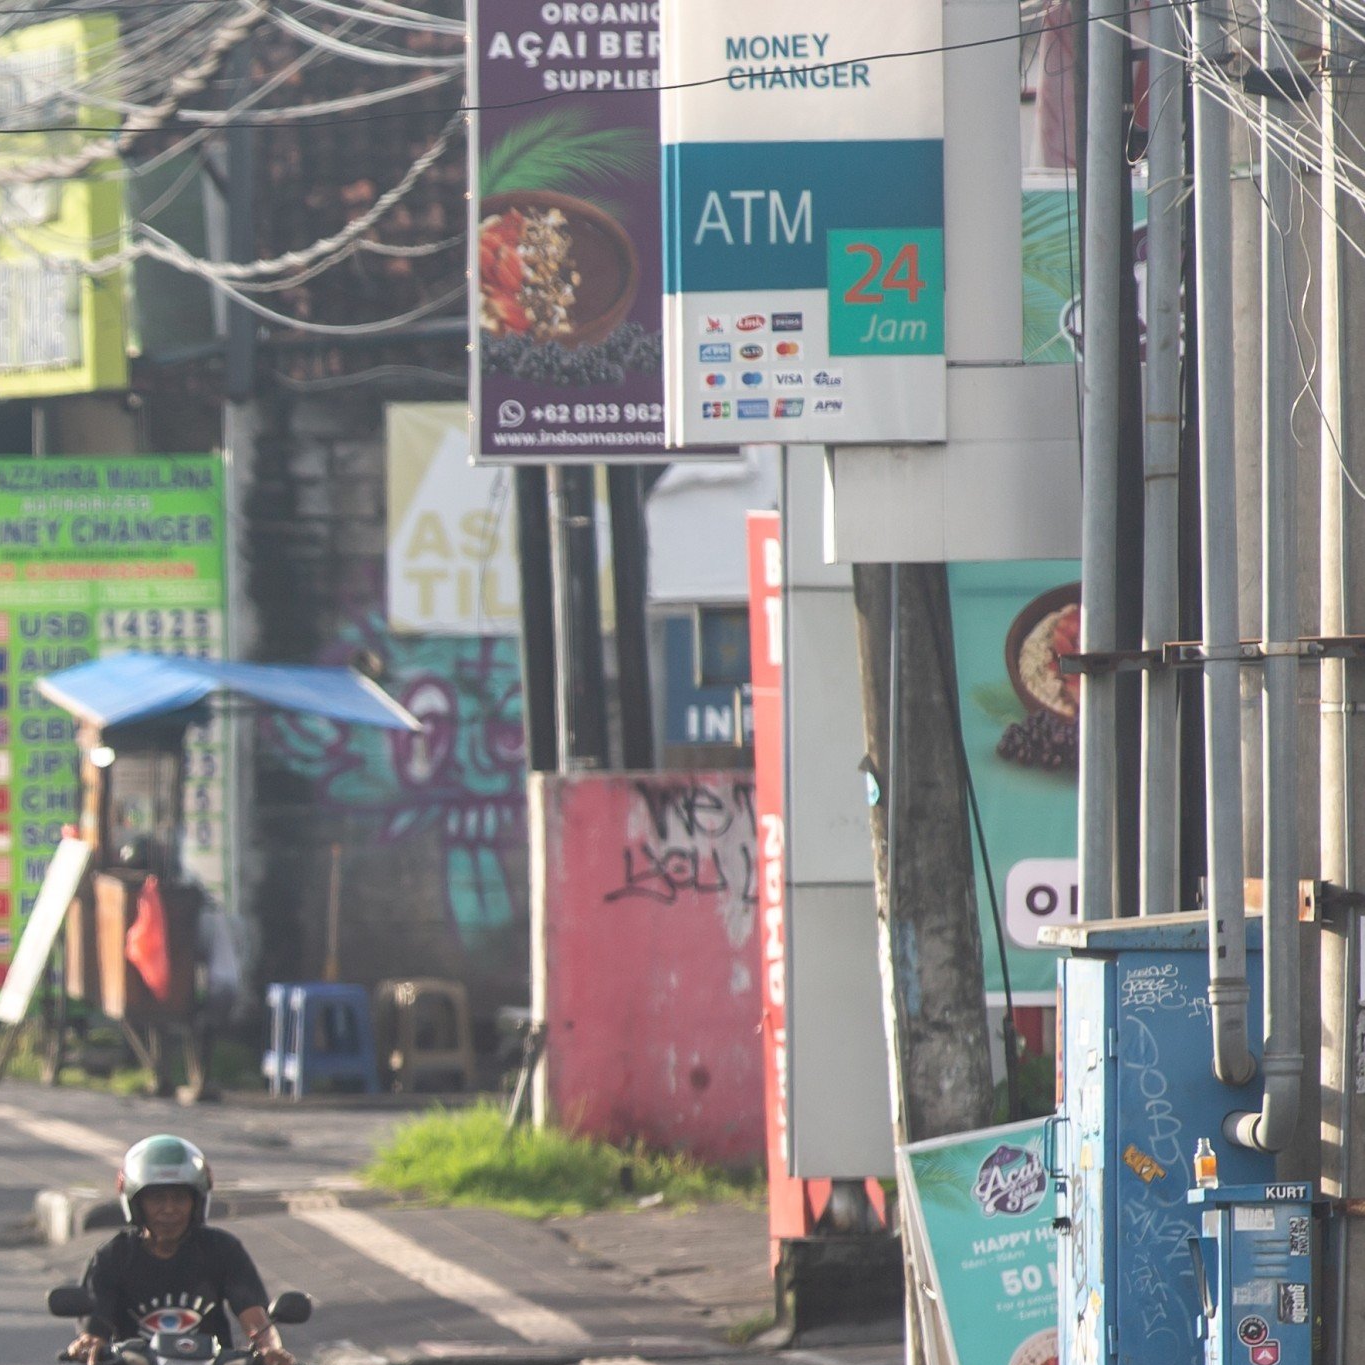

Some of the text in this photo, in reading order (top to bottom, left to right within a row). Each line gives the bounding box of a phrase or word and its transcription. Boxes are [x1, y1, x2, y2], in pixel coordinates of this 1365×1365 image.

[489, 31, 587, 68] AÇAI
[725, 33, 831, 60] MONEY
[728, 64, 871, 91] CHANGER
[694, 190, 813, 245] ATM
[843, 243, 927, 304] 24
[860, 312, 928, 343] Jam
[776, 374, 803, 385] VISA
[531, 404, 566, 423] +62
[71, 514, 214, 545] CHANGER
[20, 611, 90, 641] USD
[1265, 1186, 1307, 1199] KURT
[972, 1229, 1033, 1256] HAPPY
[1001, 1264, 1043, 1297] 50
